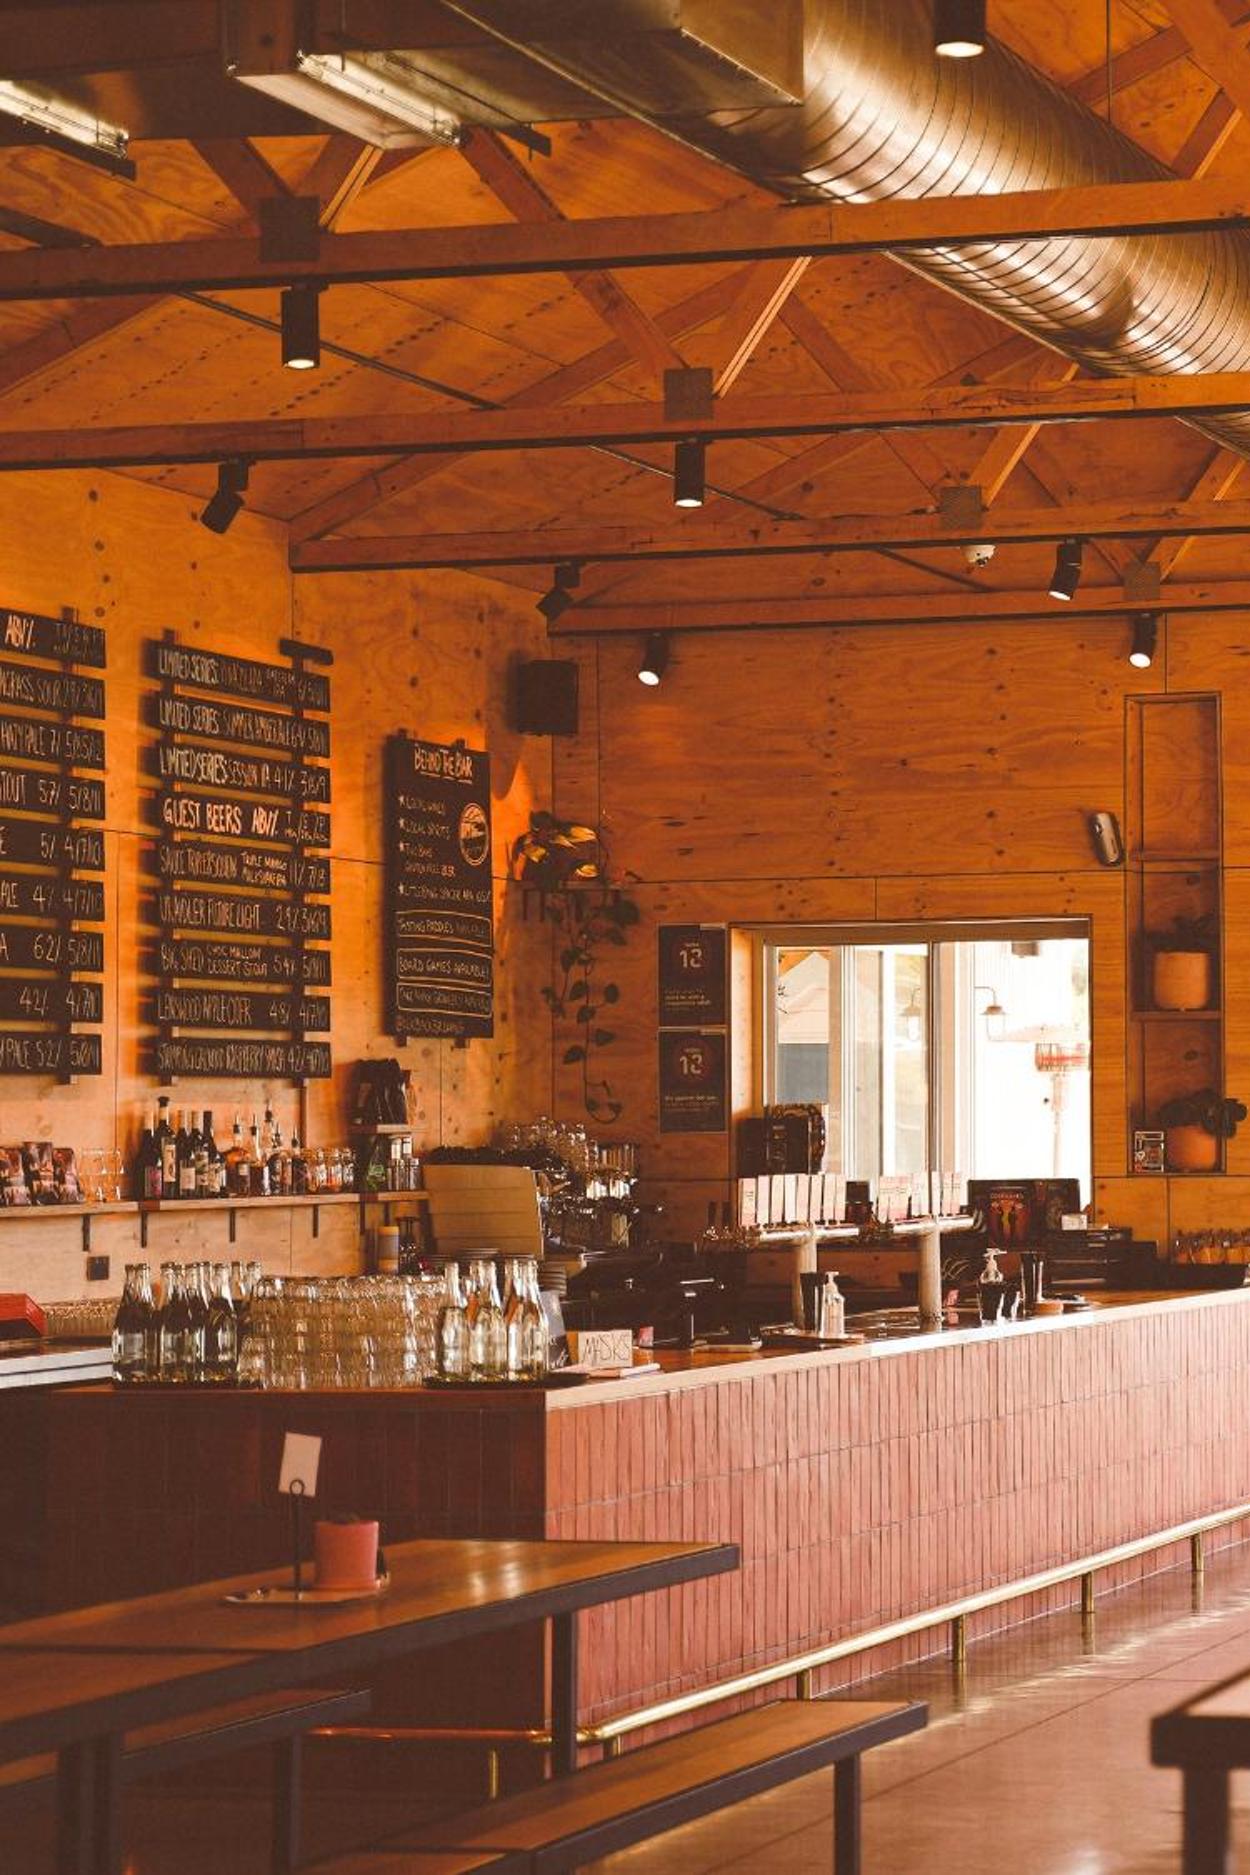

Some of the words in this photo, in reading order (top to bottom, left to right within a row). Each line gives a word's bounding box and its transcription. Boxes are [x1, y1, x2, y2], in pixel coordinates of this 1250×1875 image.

[455, 752, 473, 778] BAR
[163, 798, 200, 829] GUEST
[206, 802, 243, 835] BEERS
[399, 956, 424, 973] BOARD
[425, 958, 452, 974] GAMES
[584, 1333, 630, 1363] MASKS
